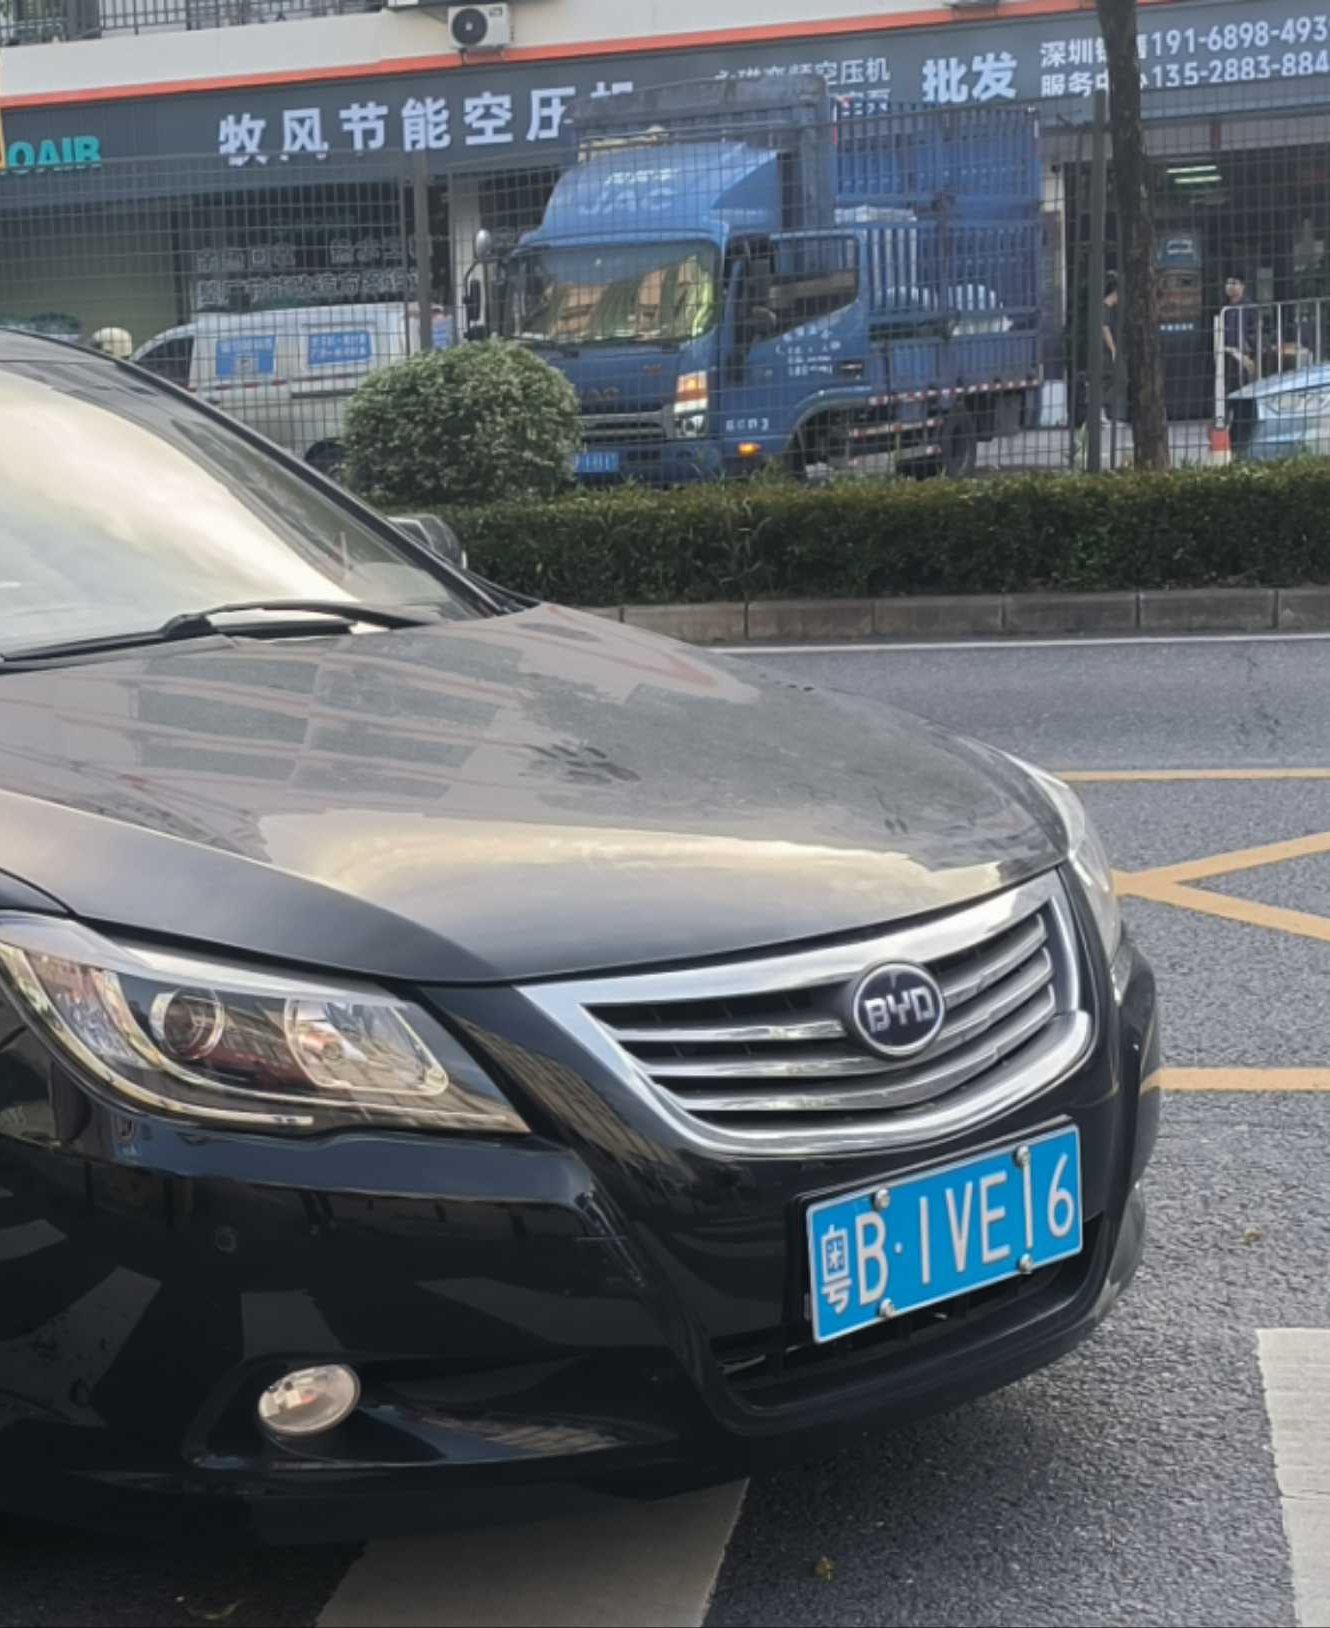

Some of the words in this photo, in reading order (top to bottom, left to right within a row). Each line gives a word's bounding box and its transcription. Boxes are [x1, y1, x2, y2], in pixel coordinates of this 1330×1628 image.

[1152, 15, 1330, 57] 191-6898-493
[922, 51, 1017, 103] 批发
[218, 81, 634, 167] 牧风节能空压
[864, 986, 935, 1033] BYD
